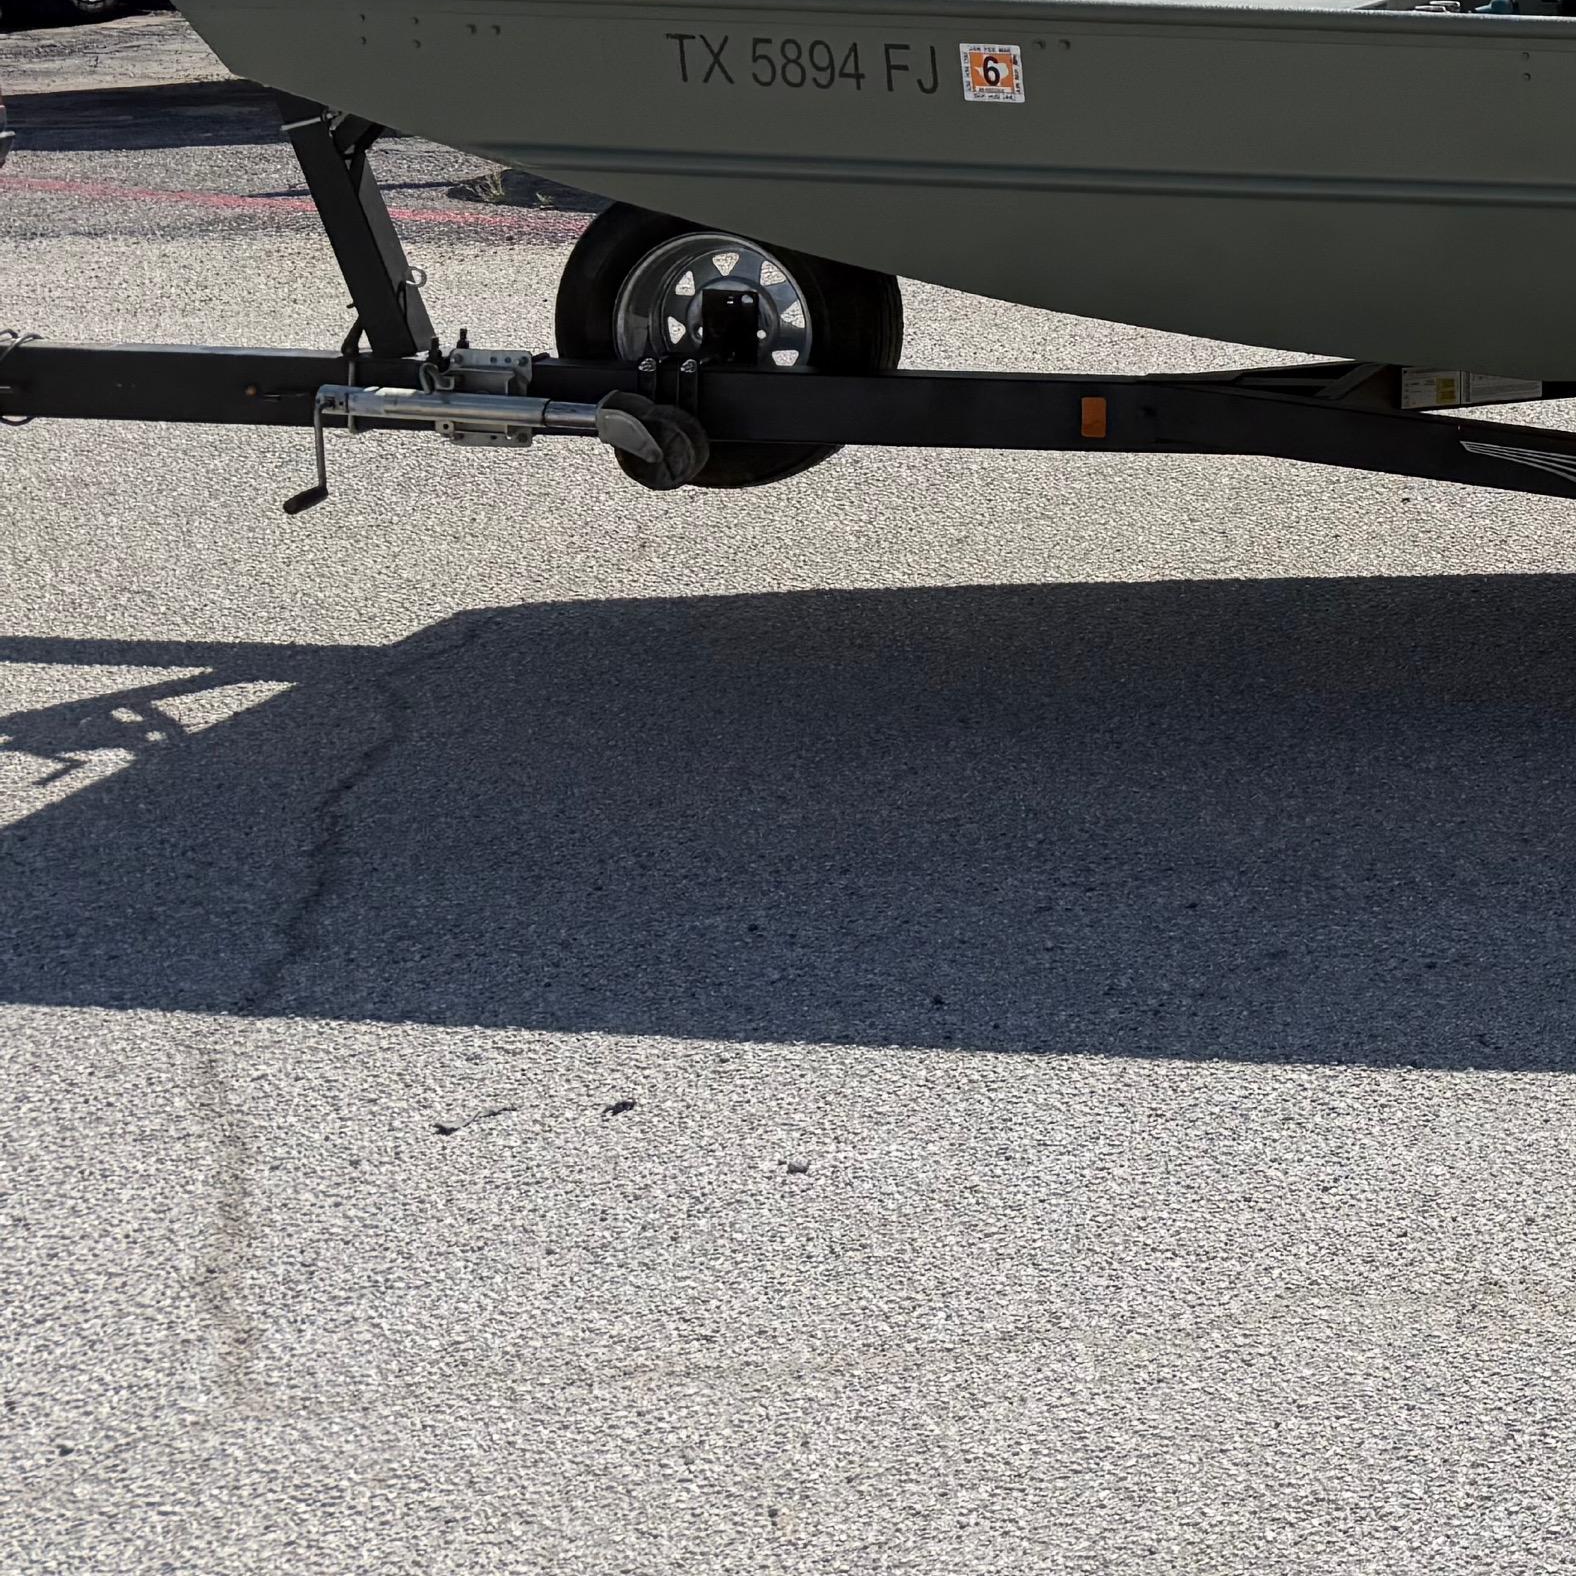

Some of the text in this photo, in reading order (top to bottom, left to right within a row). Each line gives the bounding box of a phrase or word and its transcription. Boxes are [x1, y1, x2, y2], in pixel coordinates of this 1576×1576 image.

[665, 33, 735, 84] TX
[751, 37, 866, 91] 5894
[884, 43, 939, 94] FJ
[983, 56, 1000, 86] 6
